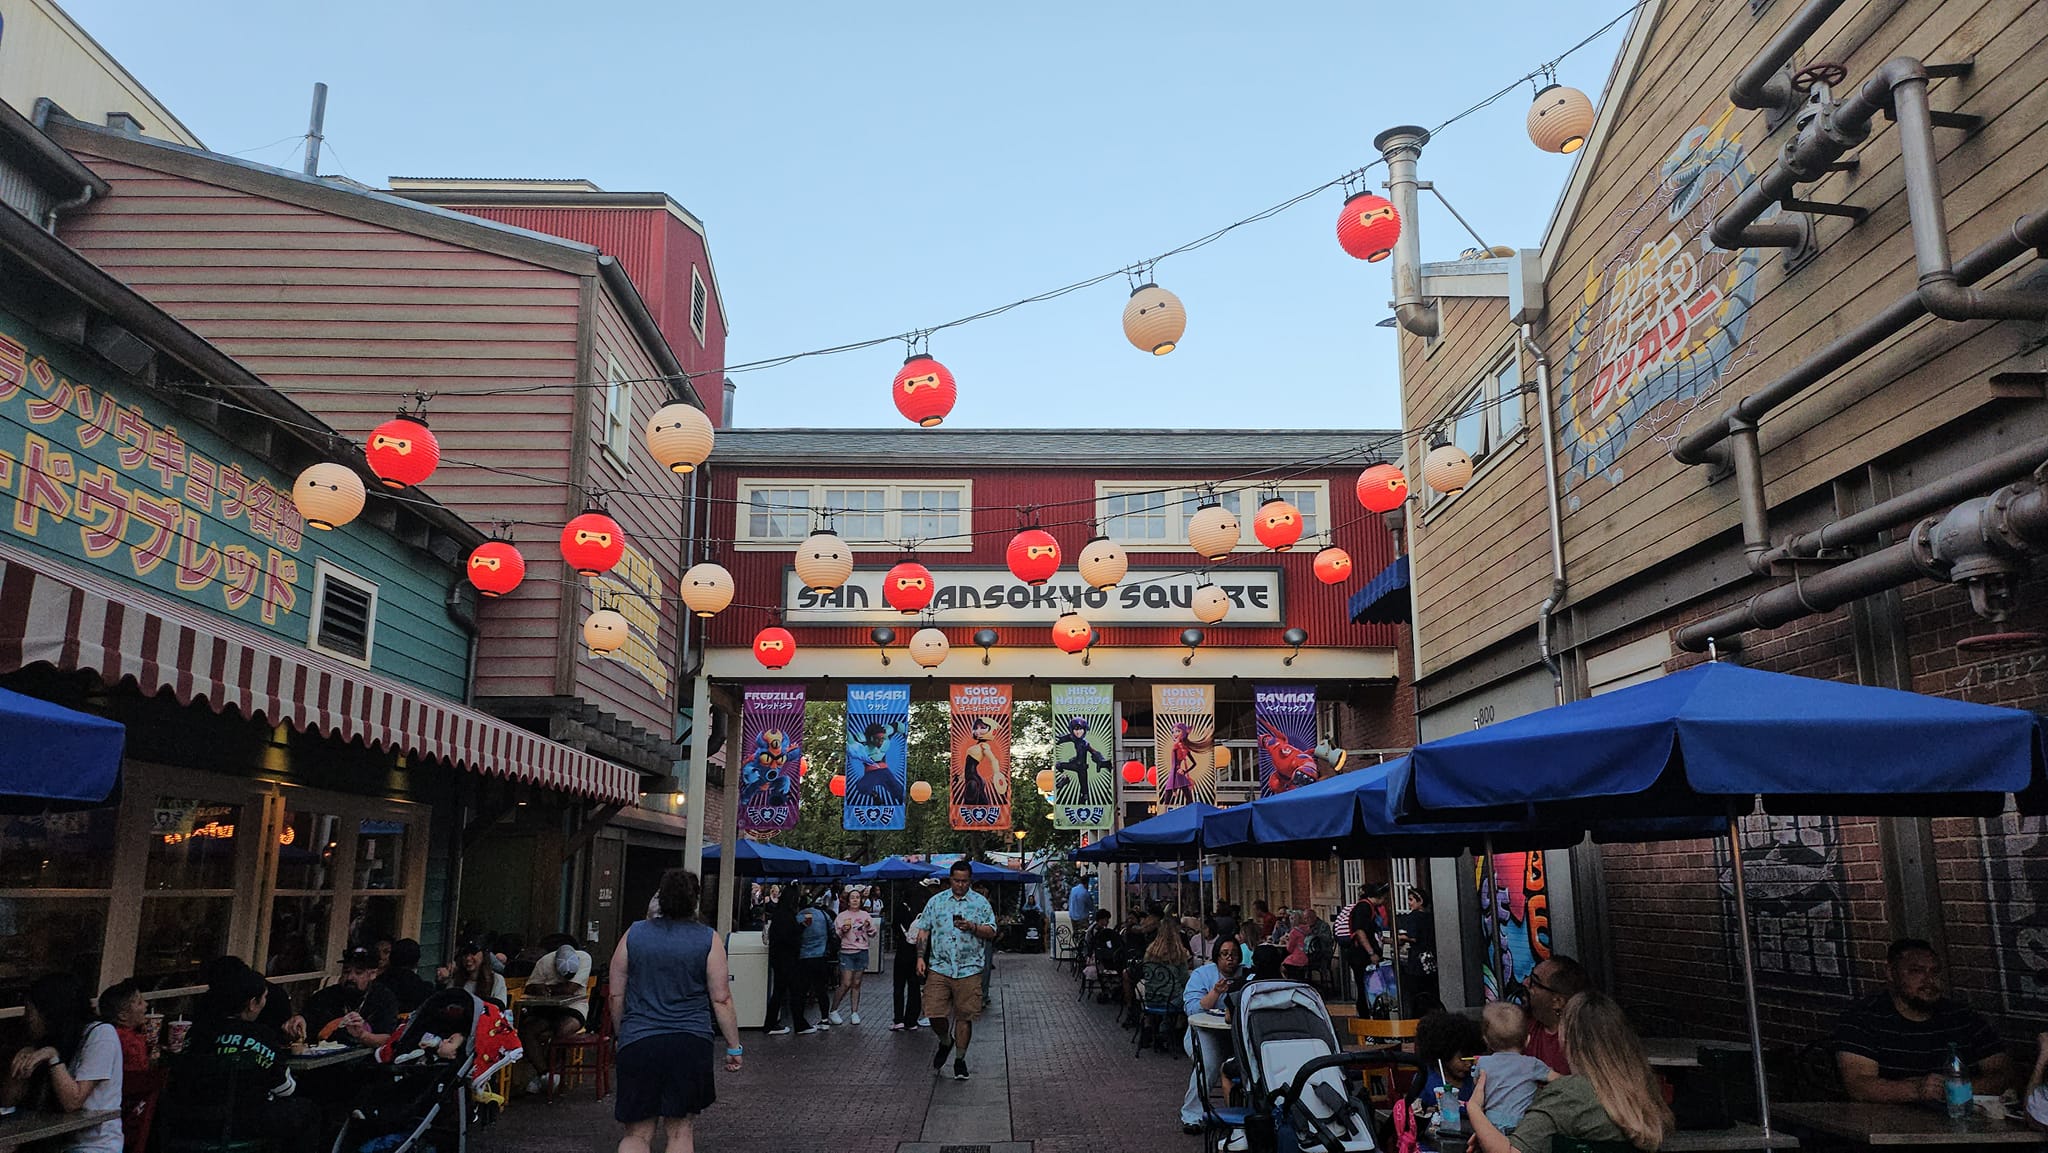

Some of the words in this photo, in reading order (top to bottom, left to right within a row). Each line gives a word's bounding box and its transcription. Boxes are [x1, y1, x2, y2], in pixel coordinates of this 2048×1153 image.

[1591, 285, 1723, 420] クッカリー
[797, 585, 869, 609] SAN
[882, 585, 1108, 609] ANSOKYO
[1119, 585, 1269, 609] SQURE
[744, 692, 804, 700] FREDZILLA
[850, 690, 906, 700] WASABI
[964, 687, 998, 696] GOGO
[1067, 687, 1097, 695] HIRO
[1162, 688, 1204, 697] HONEY
[954, 695, 1007, 705] TOMAGO
[1055, 695, 1110, 705] HAMADA
[1161, 696, 1206, 706] LEMON
[1256, 692, 1315, 703] BAYMAX
[753, 702, 793, 710] フレッドジラ
[243, 1037, 276, 1061] PATH
